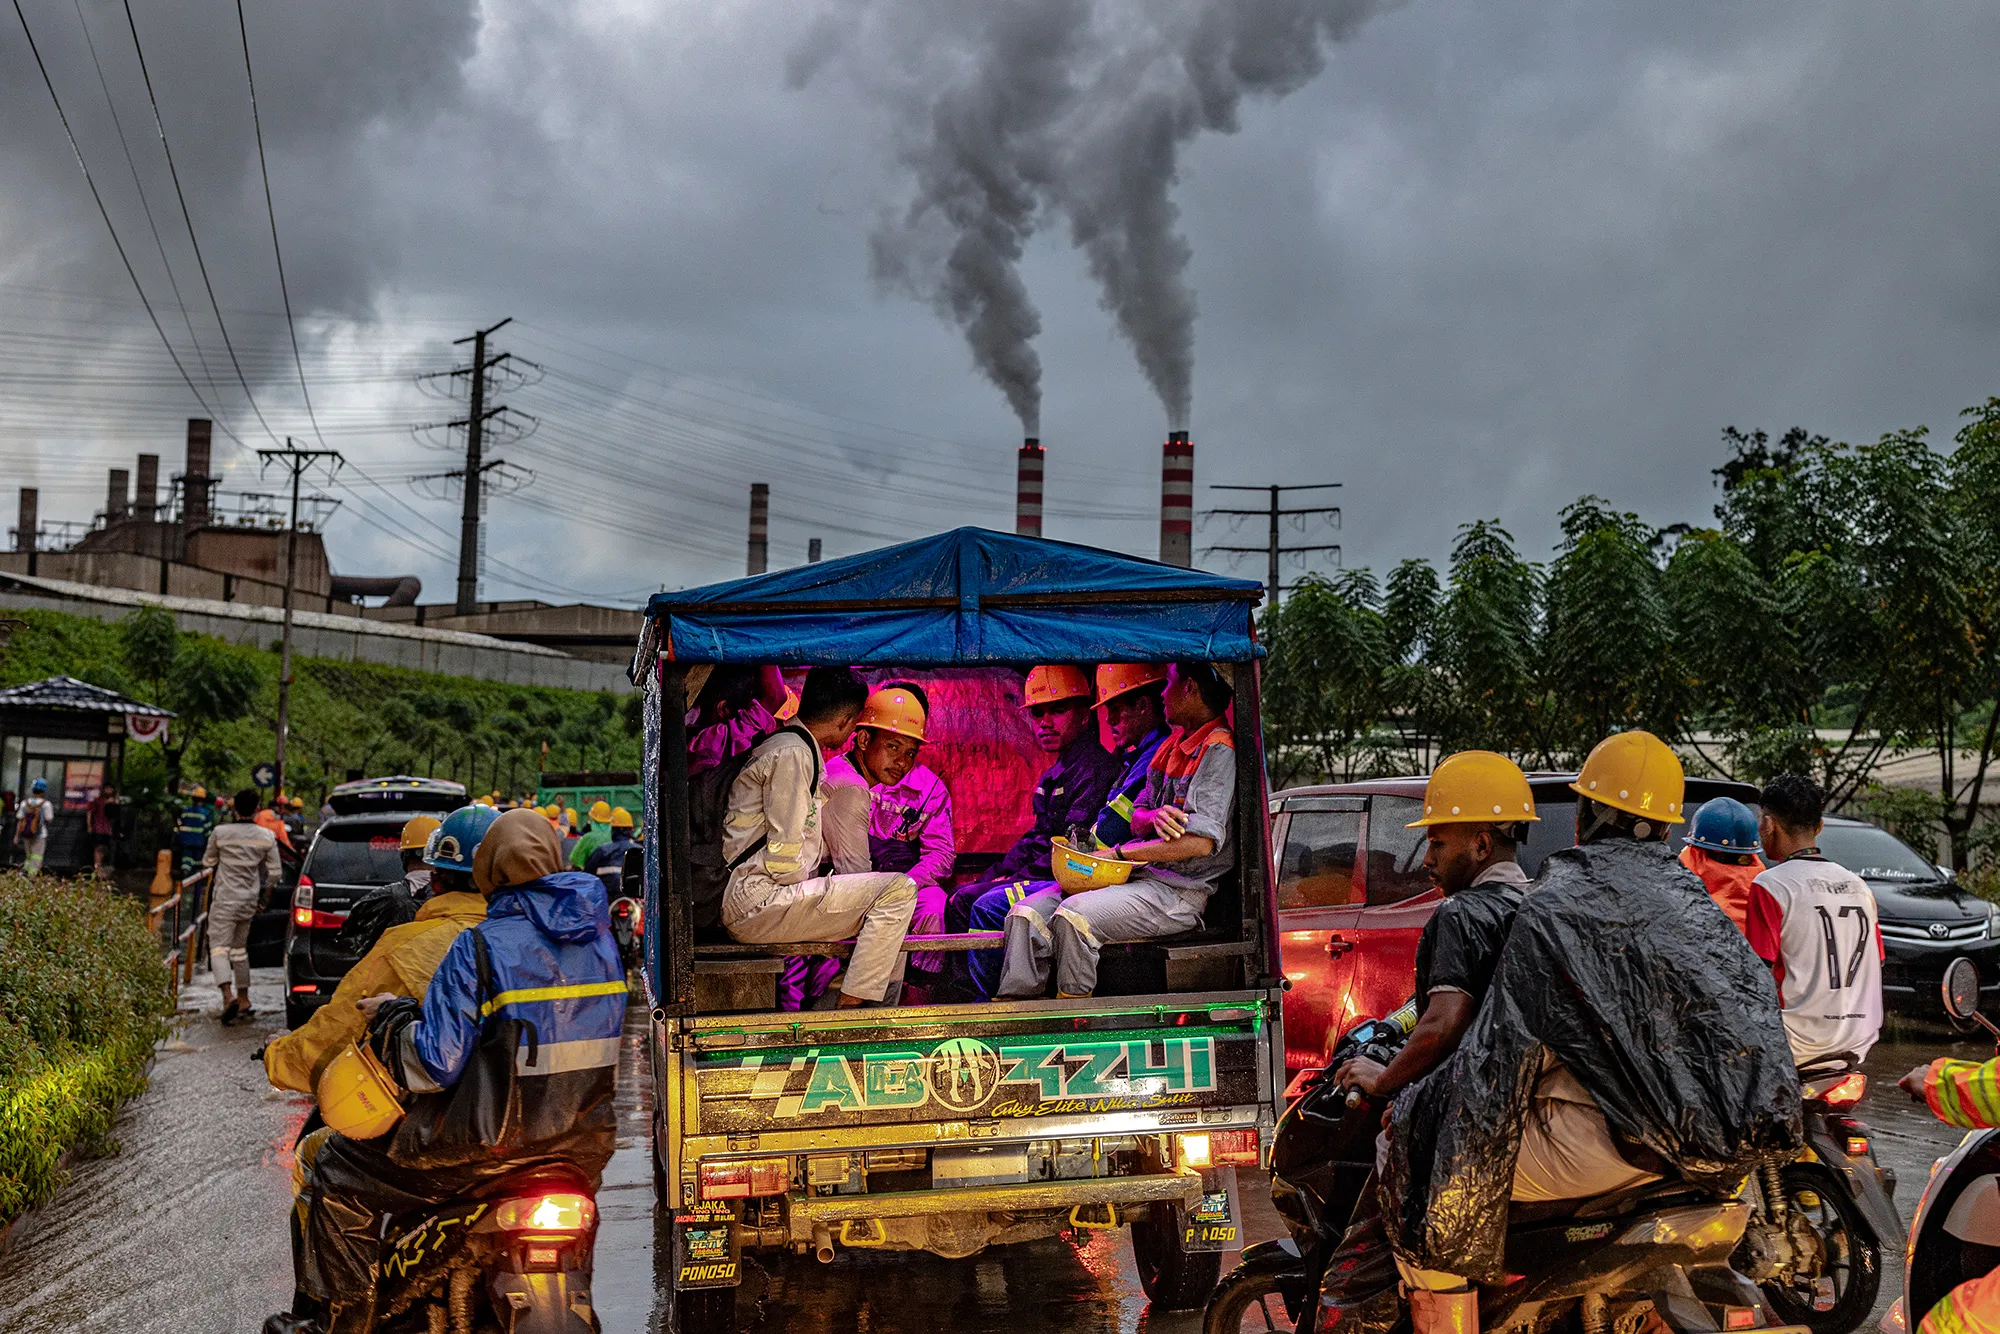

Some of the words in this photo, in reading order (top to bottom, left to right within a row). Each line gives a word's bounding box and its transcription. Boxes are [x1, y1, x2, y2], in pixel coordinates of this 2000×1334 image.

[1866, 867, 1916, 878] Edition
[1814, 905, 1869, 990] 17
[1034, 1096, 1087, 1116] Elite
[1201, 1203, 1225, 1213] CTV
[679, 1263, 736, 1281] PONOSO
